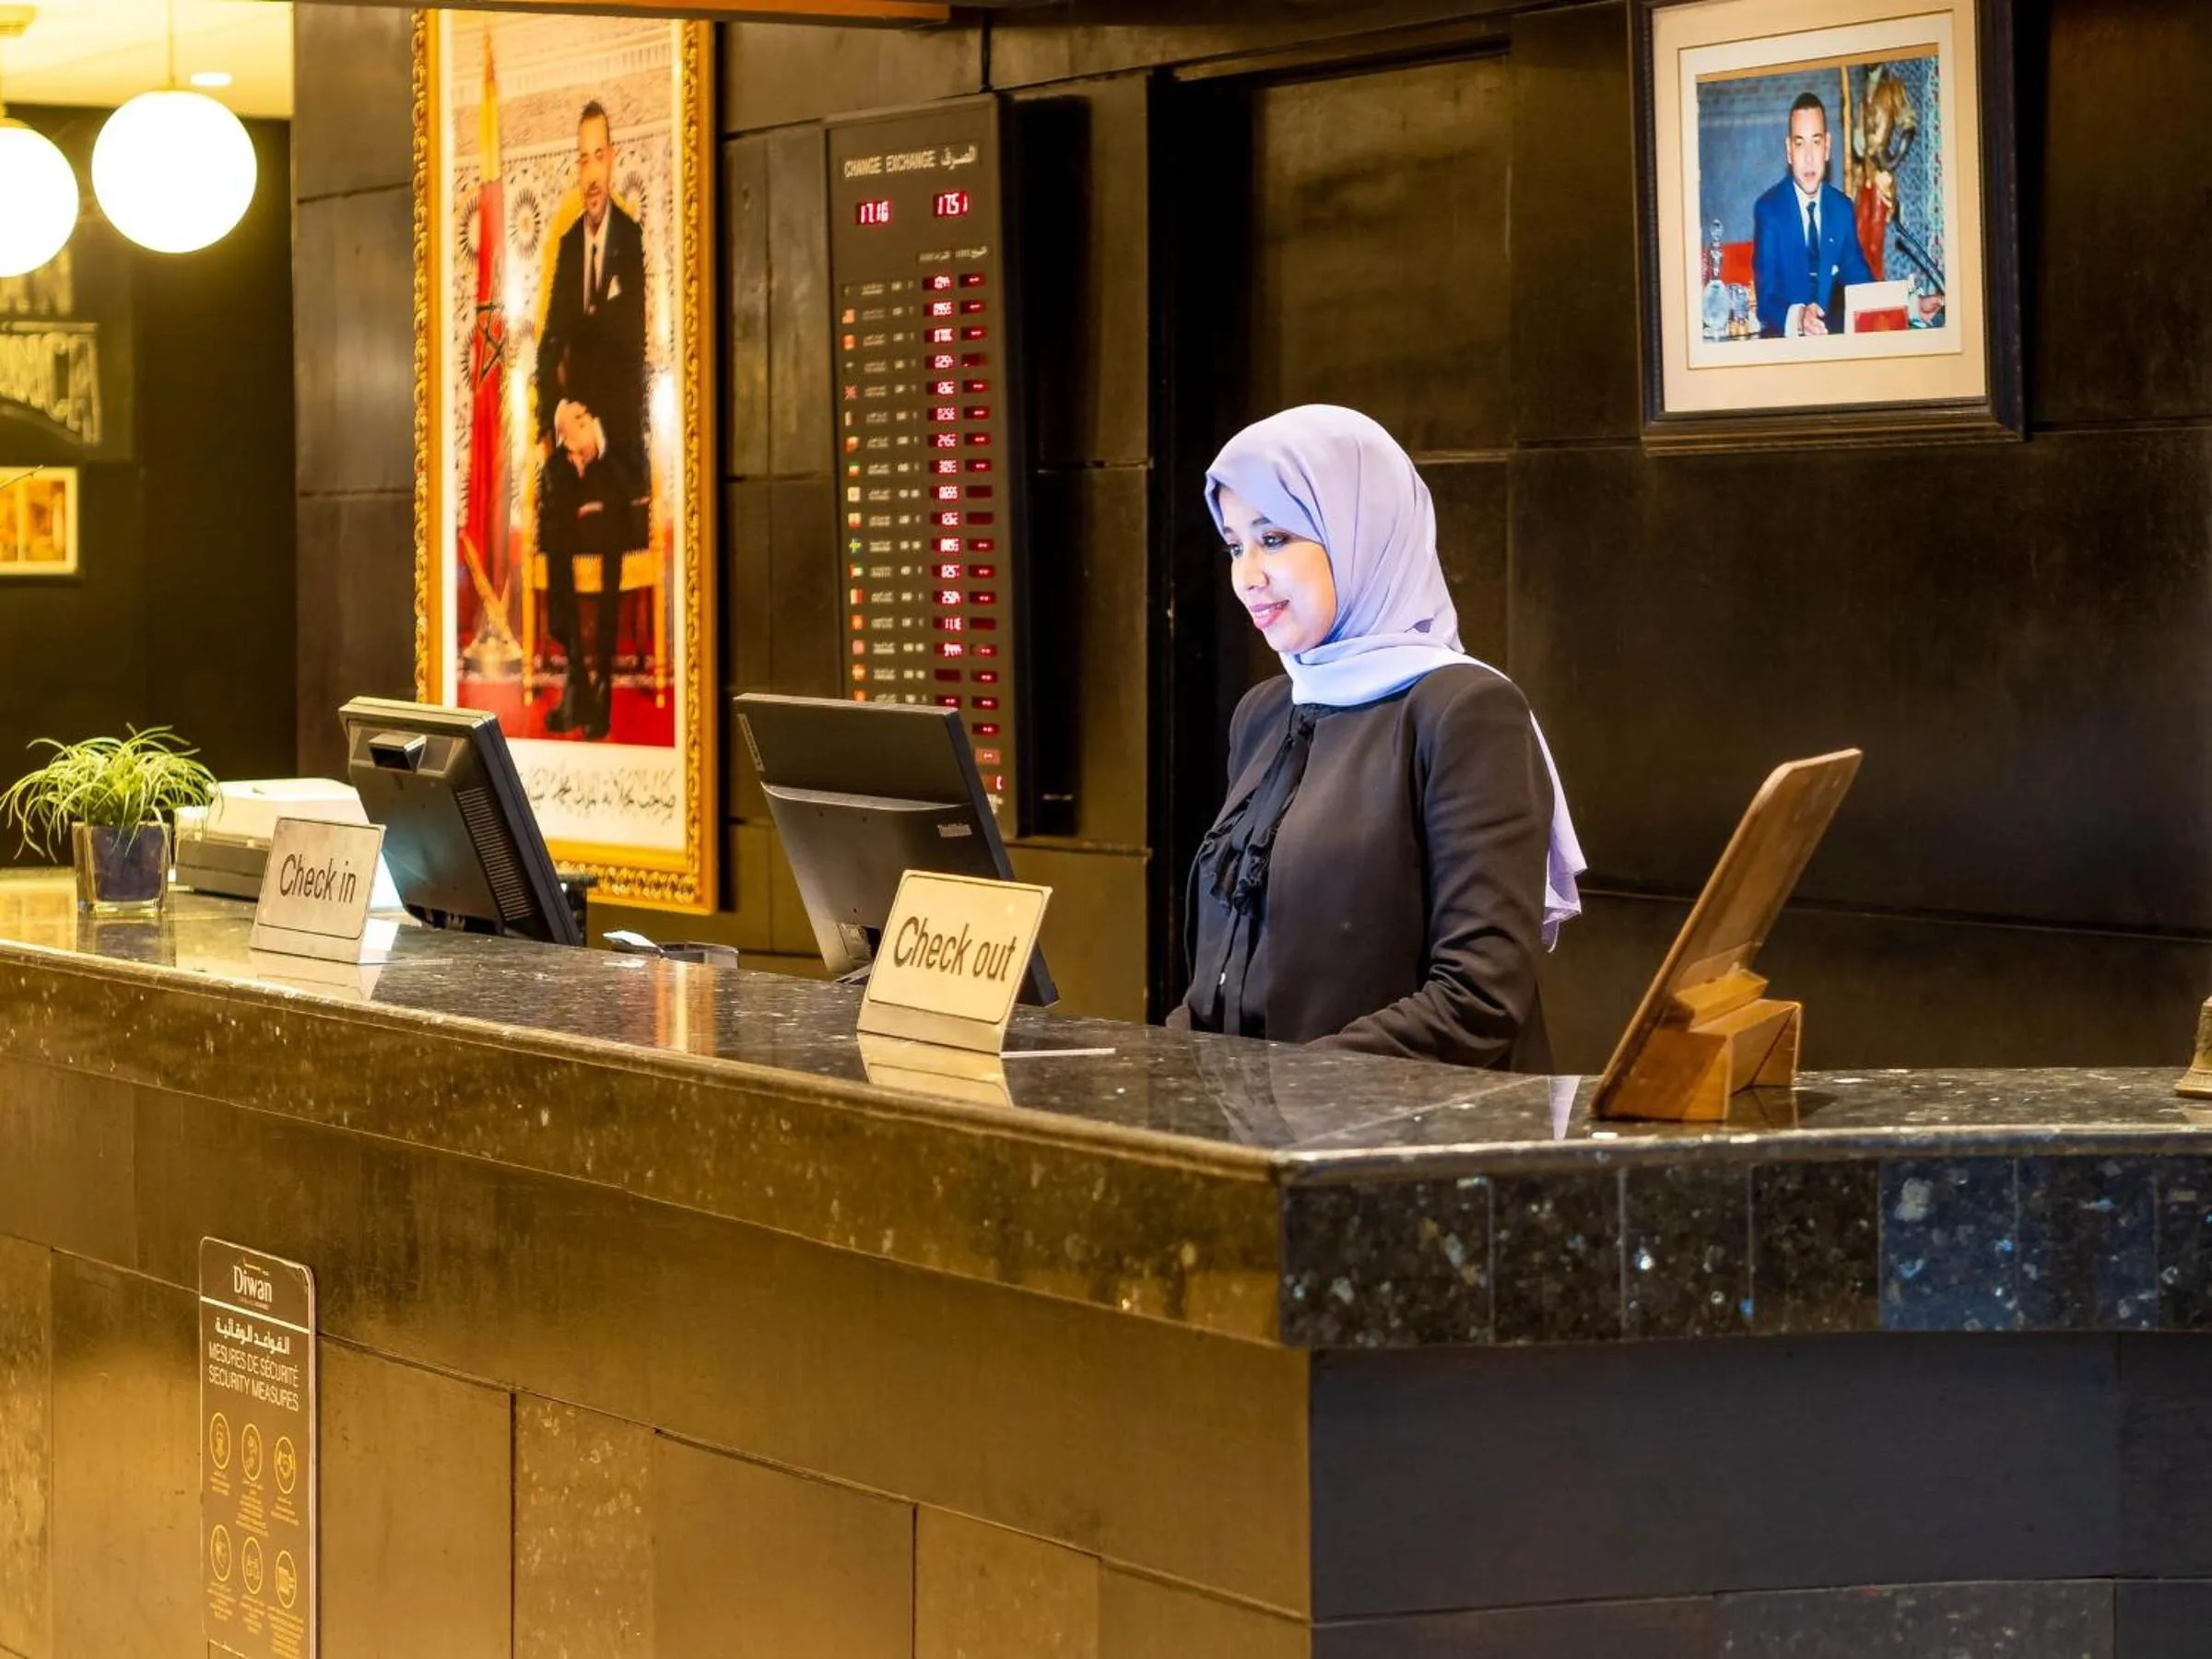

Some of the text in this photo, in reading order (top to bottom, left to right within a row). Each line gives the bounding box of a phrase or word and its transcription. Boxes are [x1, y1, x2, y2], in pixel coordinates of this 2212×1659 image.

[844, 150, 936, 178] CHANGE EXCHANGE
[279, 853, 357, 904] Check in
[893, 916, 1018, 982] Check out
[232, 1265, 273, 1303] Diwan
[208, 1341, 300, 1388] MESURES DE SÉCURITÉ
[253, 1329, 290, 1355] القواعد
[208, 1364, 300, 1413] SECURITY MEASURES
